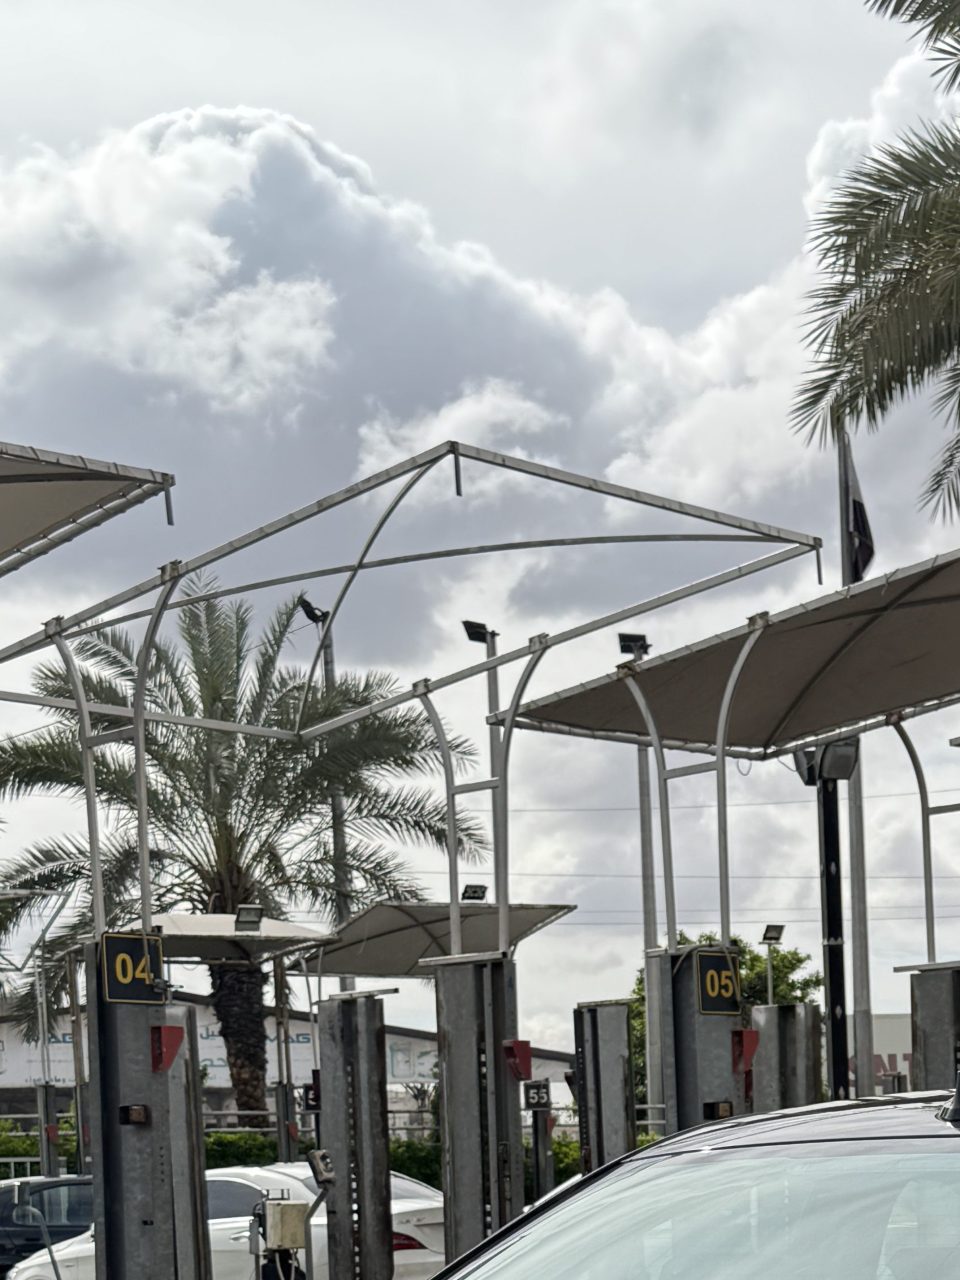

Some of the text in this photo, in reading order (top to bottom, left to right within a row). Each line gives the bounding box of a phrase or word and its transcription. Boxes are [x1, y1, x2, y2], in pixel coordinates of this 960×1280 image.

[115, 953, 154, 985] 04
[705, 969, 734, 998] 05
[529, 1089, 548, 1104] 55
